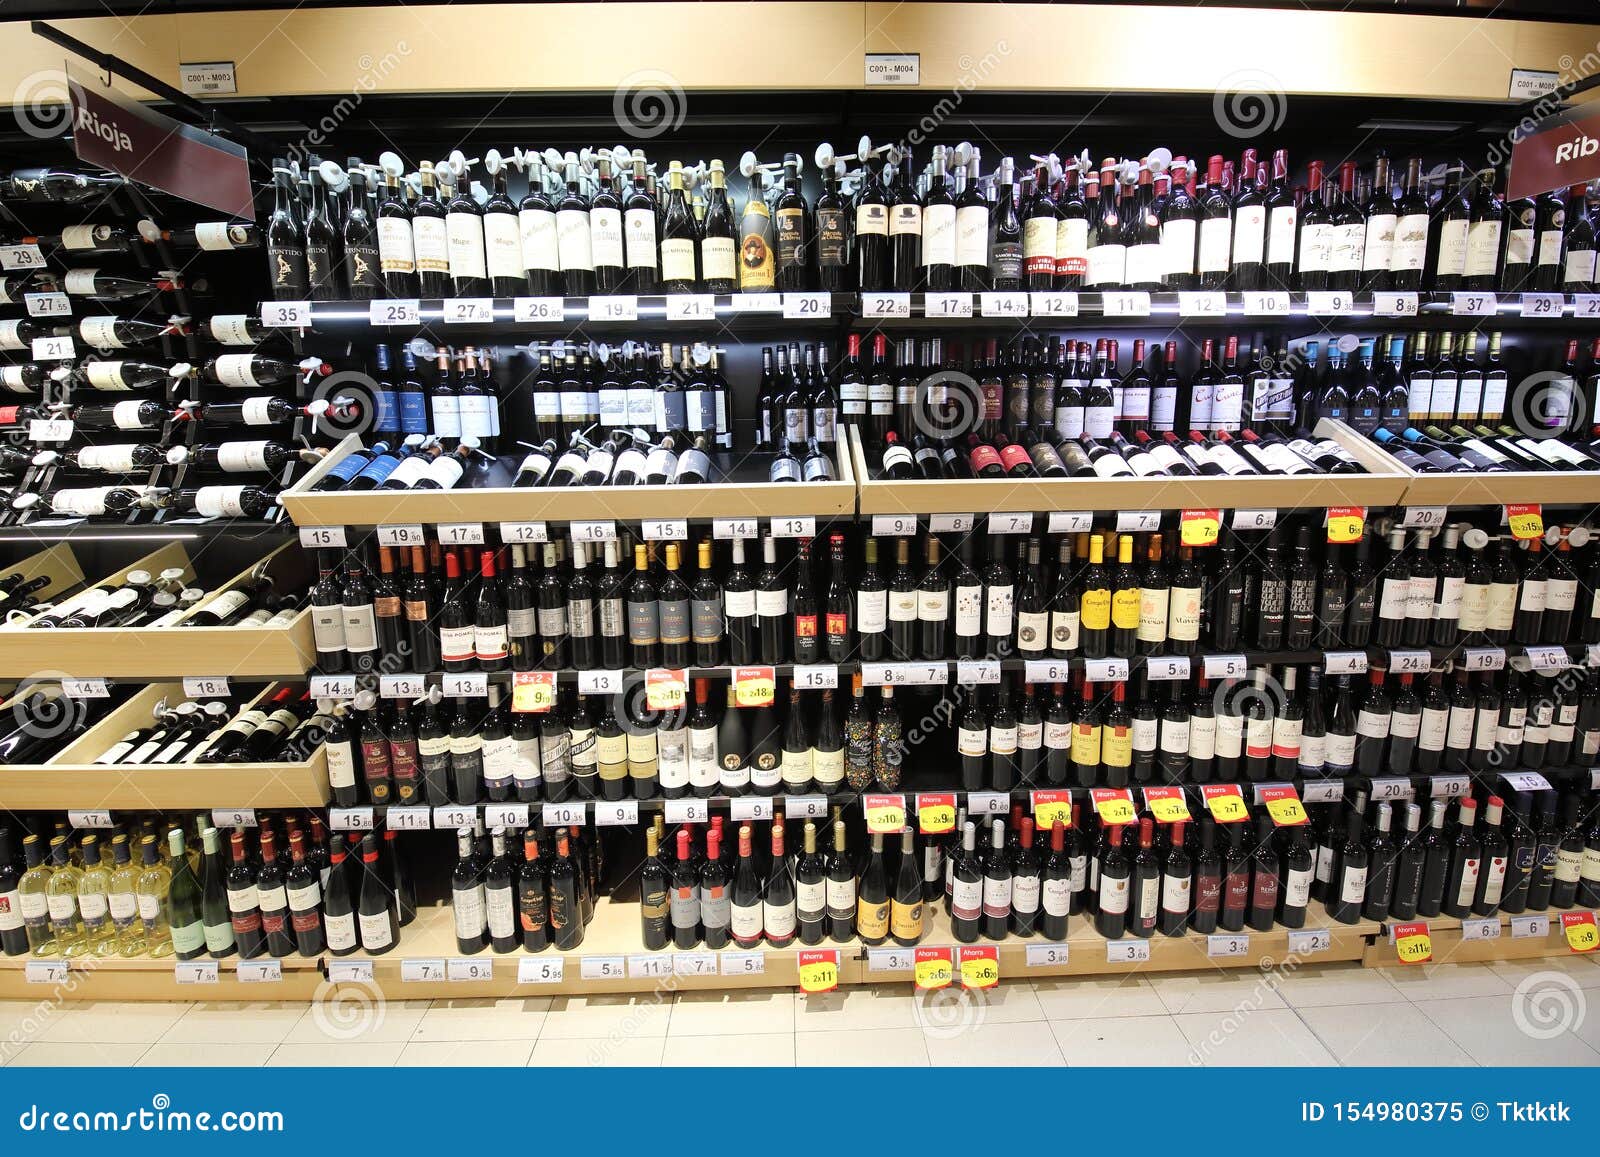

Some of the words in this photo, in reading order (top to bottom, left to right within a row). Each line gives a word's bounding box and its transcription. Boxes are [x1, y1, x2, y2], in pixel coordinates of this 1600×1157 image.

[78, 107, 133, 152] Rioja
[1556, 136, 1599, 164] Rib
[1468, 299, 1483, 311] 37
[279, 308, 297, 321] 35
[786, 521, 802, 533] 13
[312, 531, 330, 543] 15
[592, 678, 608, 688] 13
[1530, 923, 1537, 933] 6
